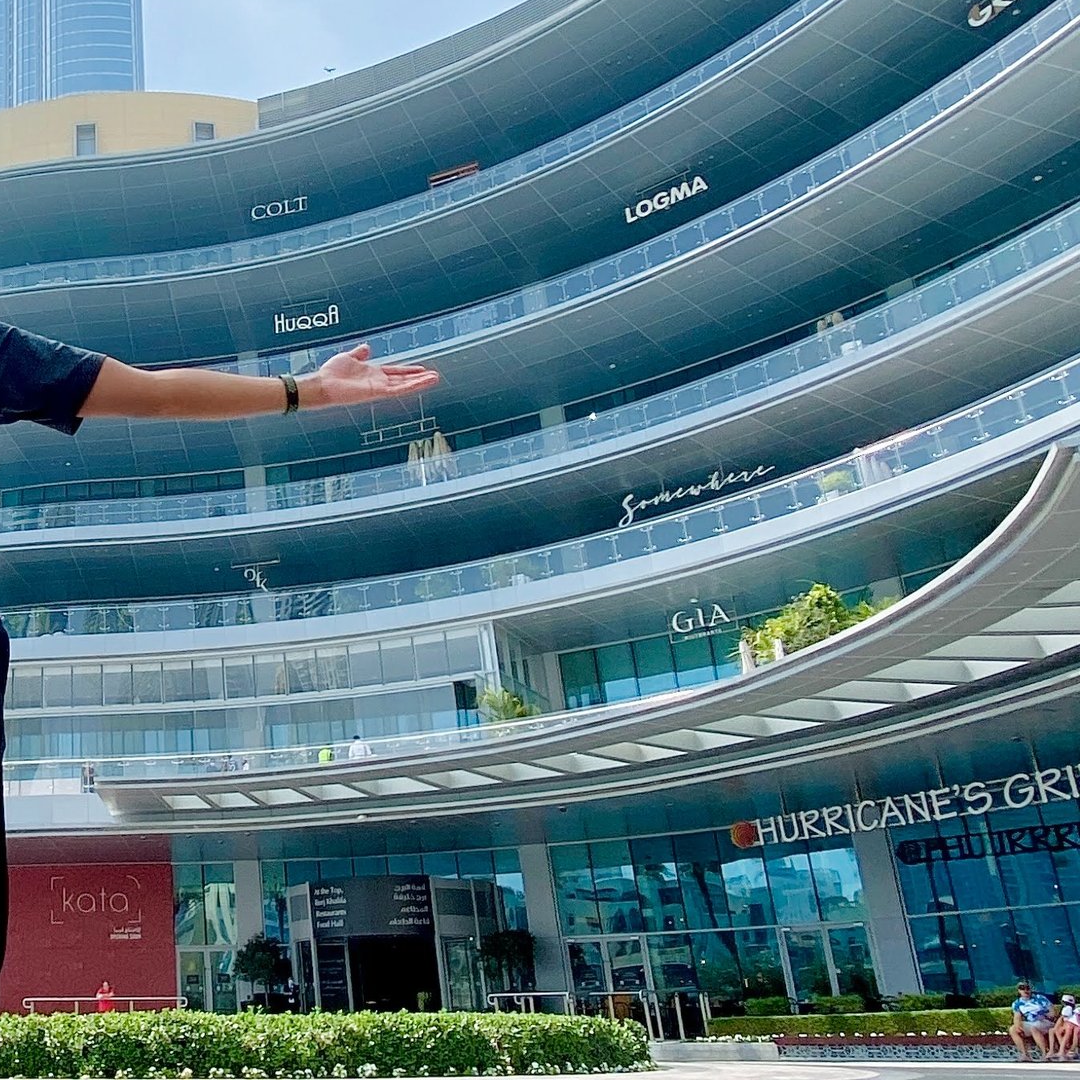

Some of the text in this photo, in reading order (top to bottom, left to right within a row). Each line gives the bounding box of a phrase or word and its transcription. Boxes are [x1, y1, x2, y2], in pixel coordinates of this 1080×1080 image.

[251, 196, 308, 220] COLT
[624, 176, 708, 224] LOGMA
[618, 465, 775, 528] Somewhere
[755, 782, 993, 846] HURRICANE'S
[1003, 764, 1080, 809] GRI
[62, 887, 129, 913] kata
